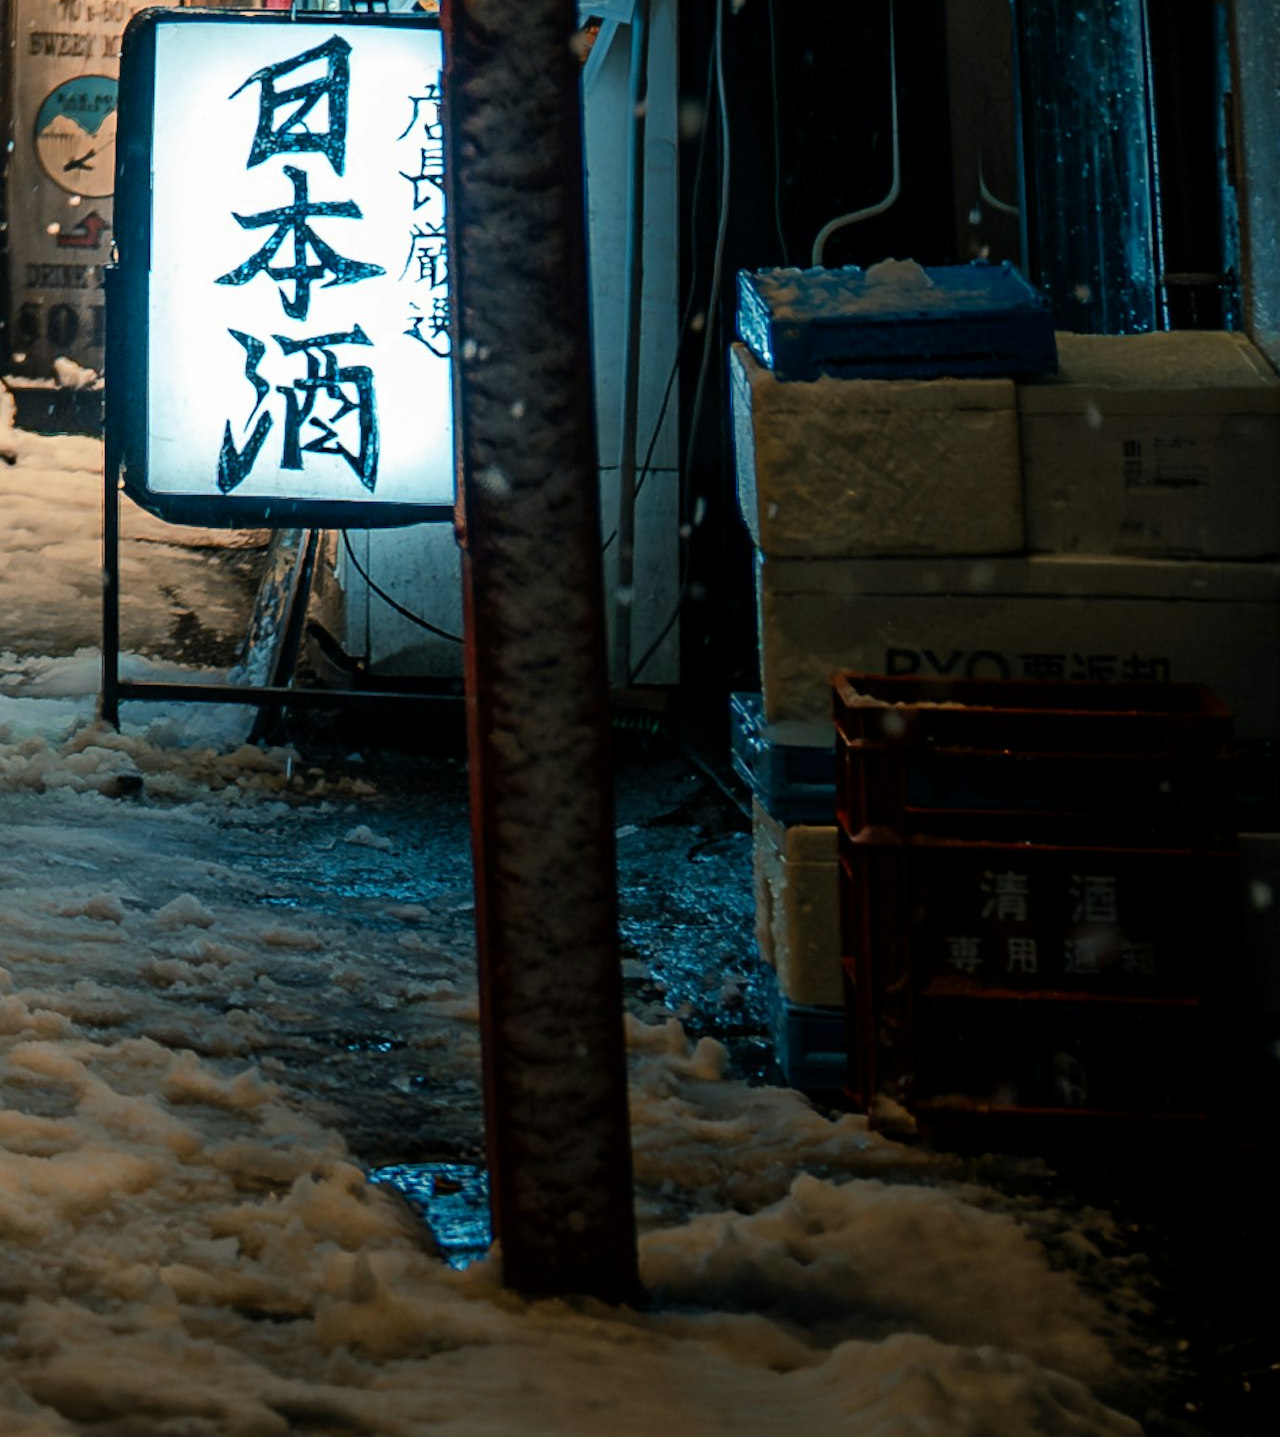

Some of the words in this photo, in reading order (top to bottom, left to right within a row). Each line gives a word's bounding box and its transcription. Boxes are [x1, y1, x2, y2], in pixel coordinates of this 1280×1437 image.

[214, 34, 387, 494] 日本酒
[979, 869, 1119, 924] 清酒
